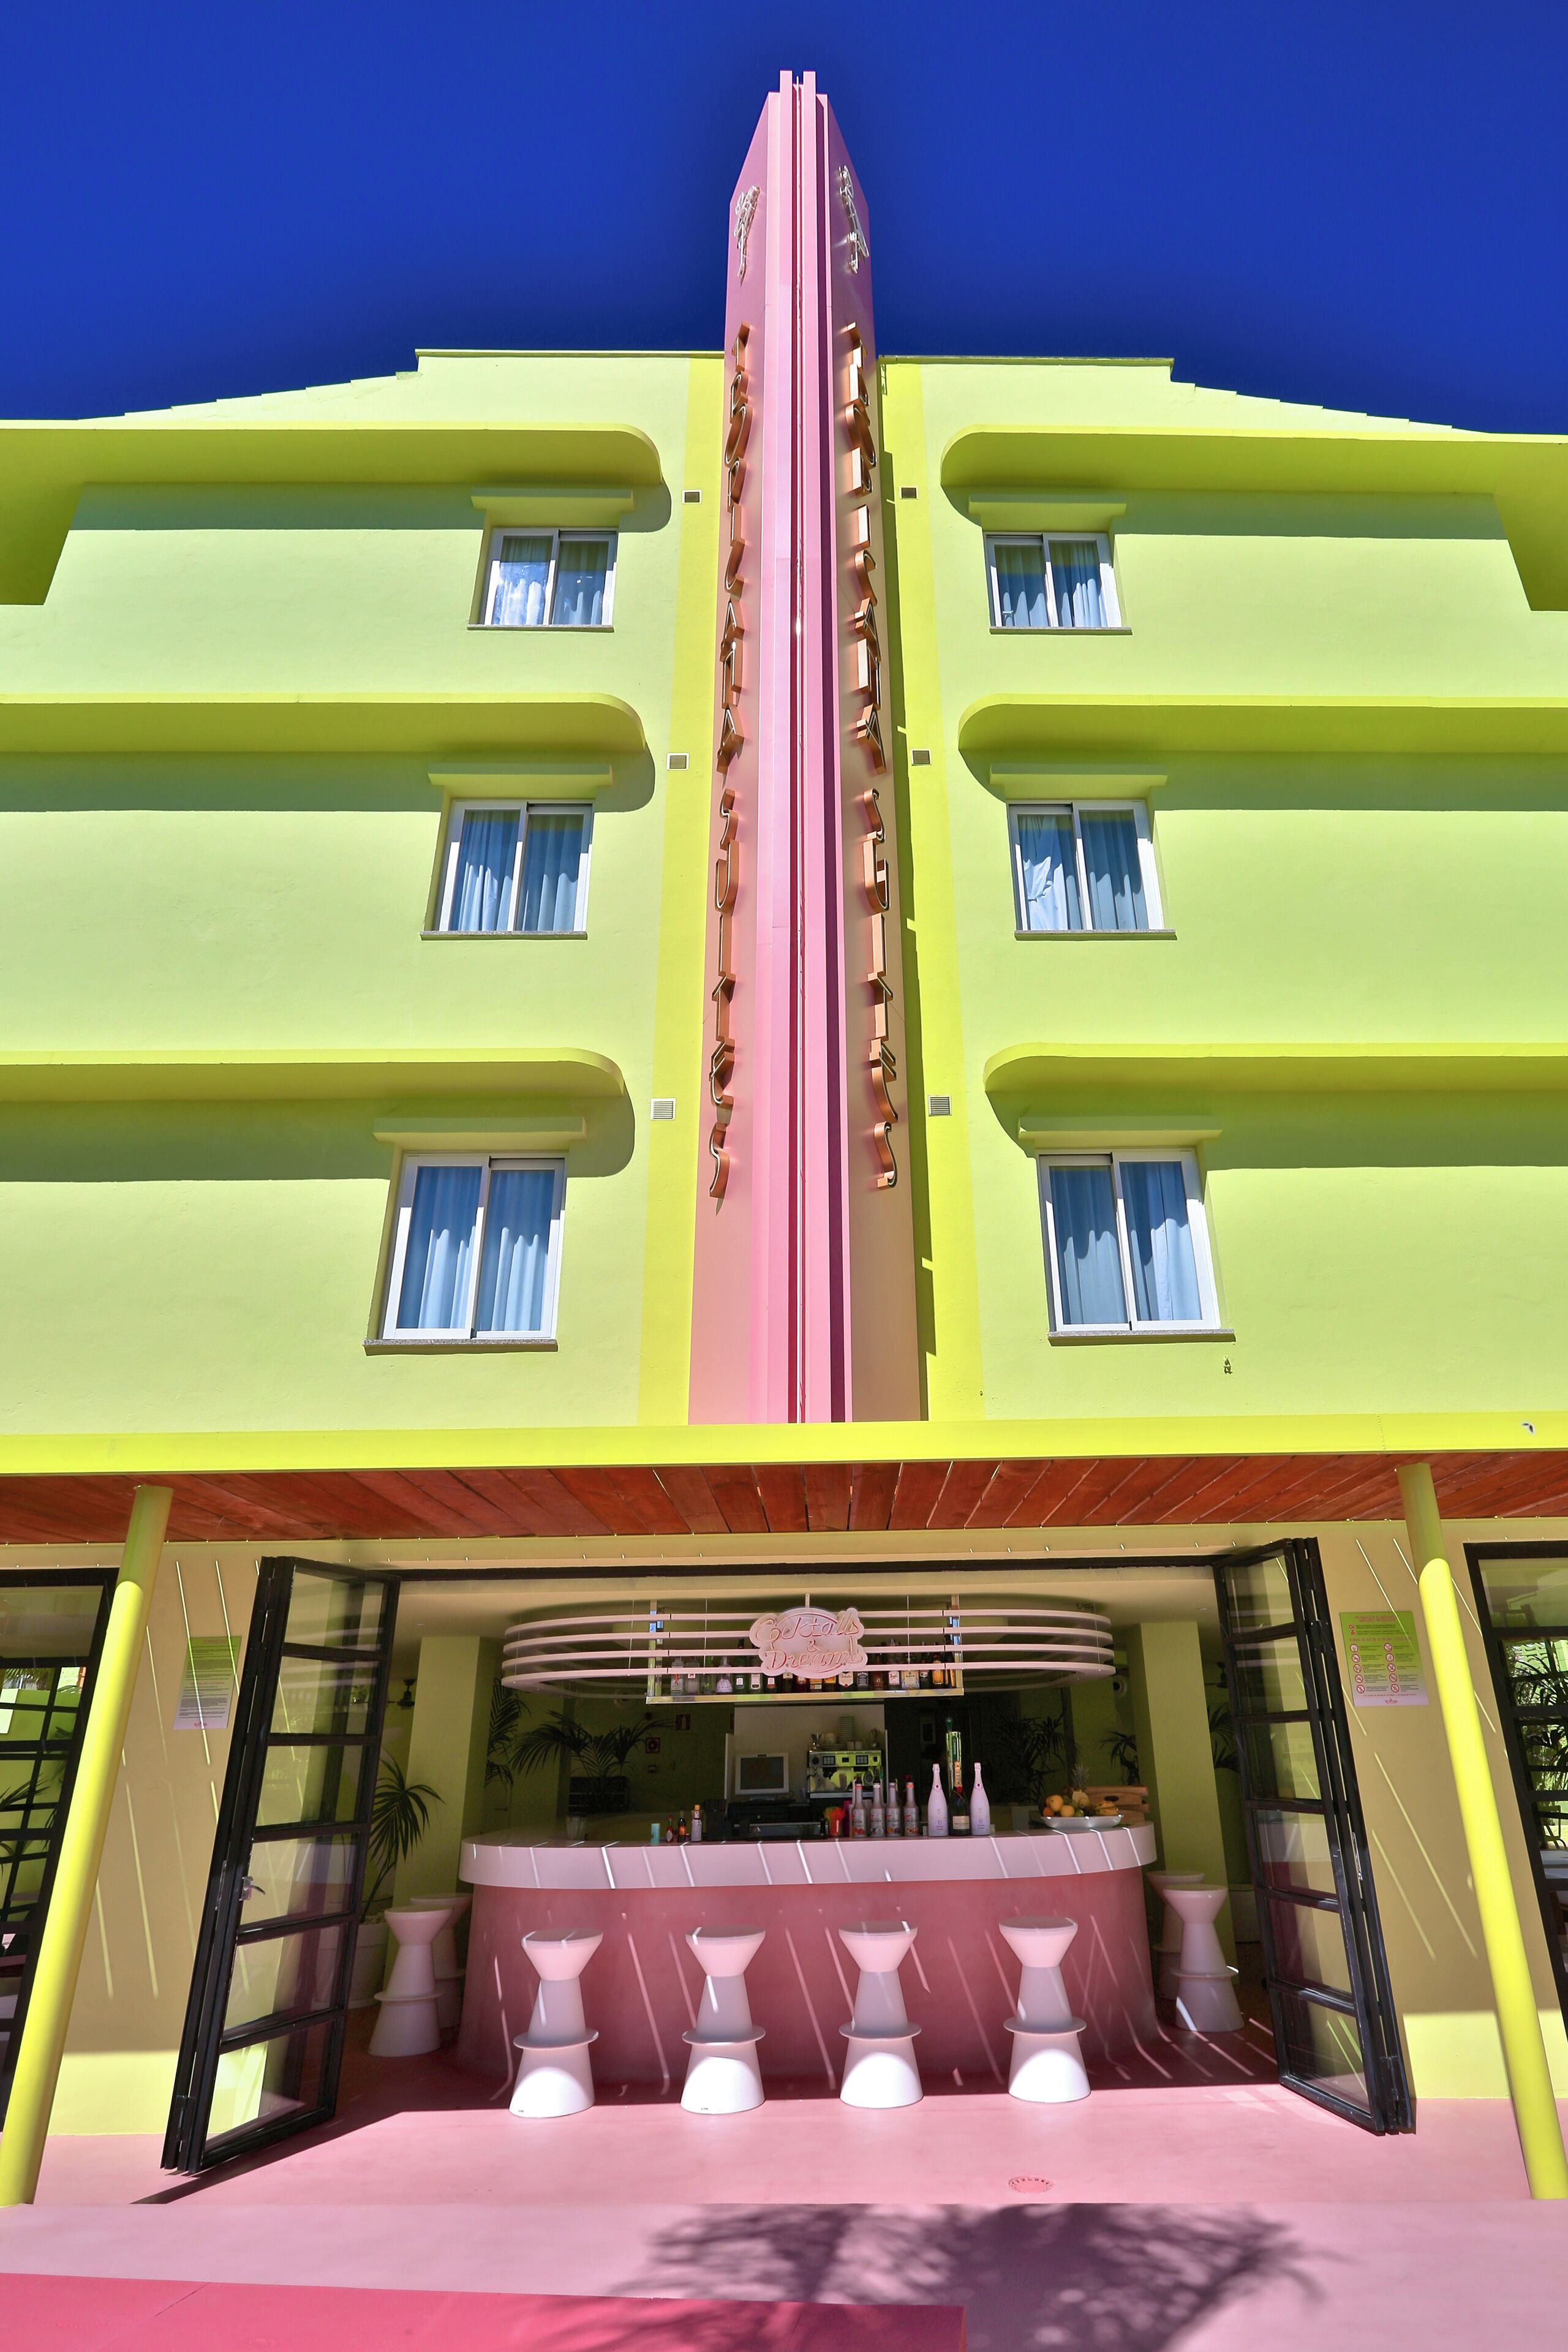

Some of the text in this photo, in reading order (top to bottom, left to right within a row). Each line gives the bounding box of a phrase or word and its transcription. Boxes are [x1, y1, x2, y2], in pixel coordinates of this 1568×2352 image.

[709, 788, 739, 1198] SUITES
[862, 788, 899, 1188] SUITES
[756, 1614, 860, 1642] Cocktails
[764, 1649, 864, 1670] Dreams
[807, 1638, 820, 1653] &
